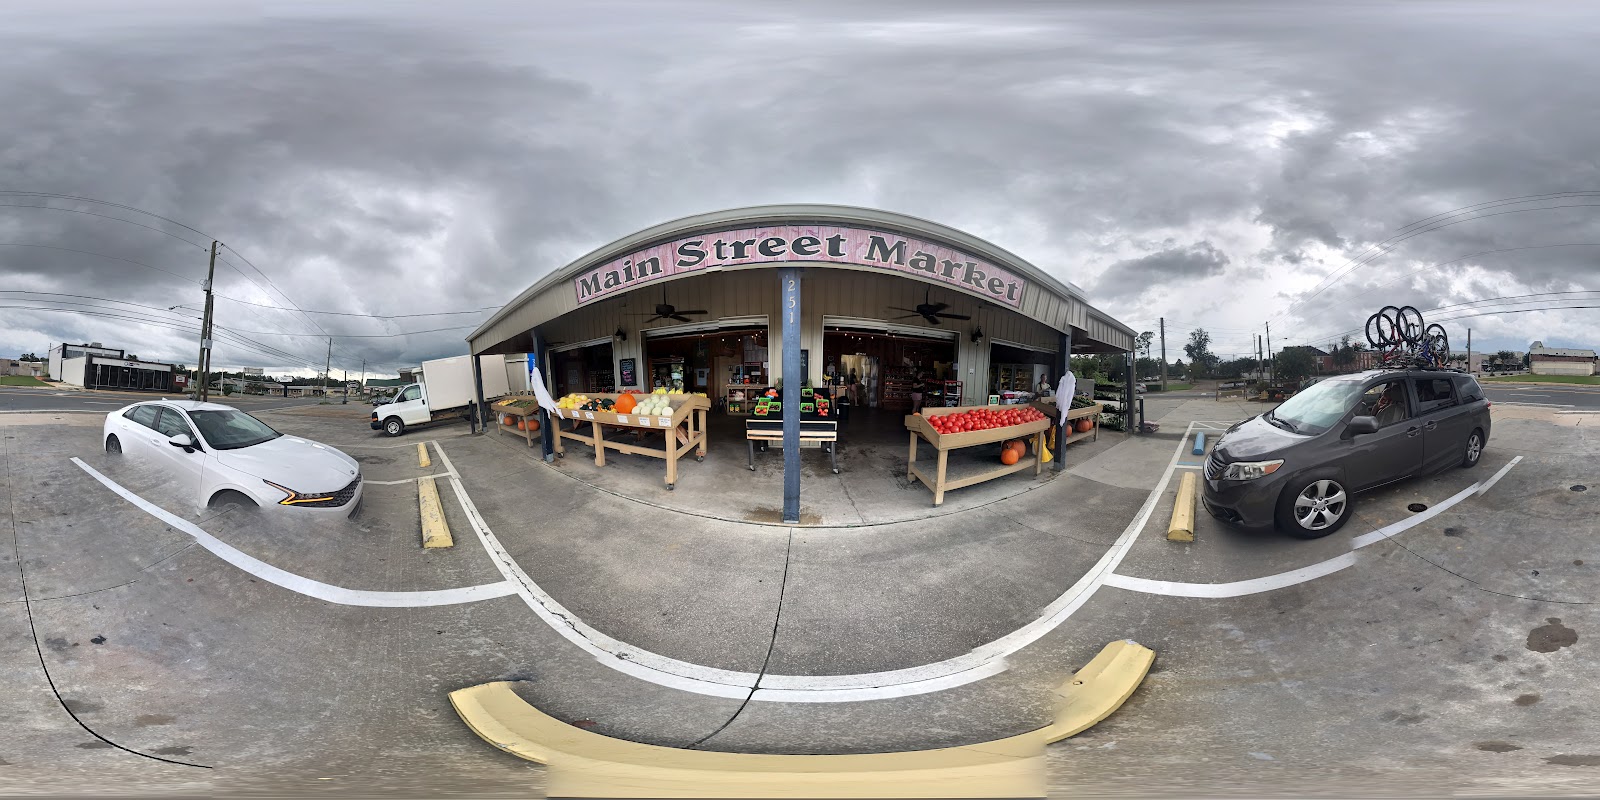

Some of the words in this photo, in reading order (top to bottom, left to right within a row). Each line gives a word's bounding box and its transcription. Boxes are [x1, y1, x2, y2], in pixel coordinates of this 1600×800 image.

[579, 254, 663, 300] Main
[675, 233, 847, 268] Street
[864, 235, 1019, 302] Market
[787, 279, 796, 324] 251
